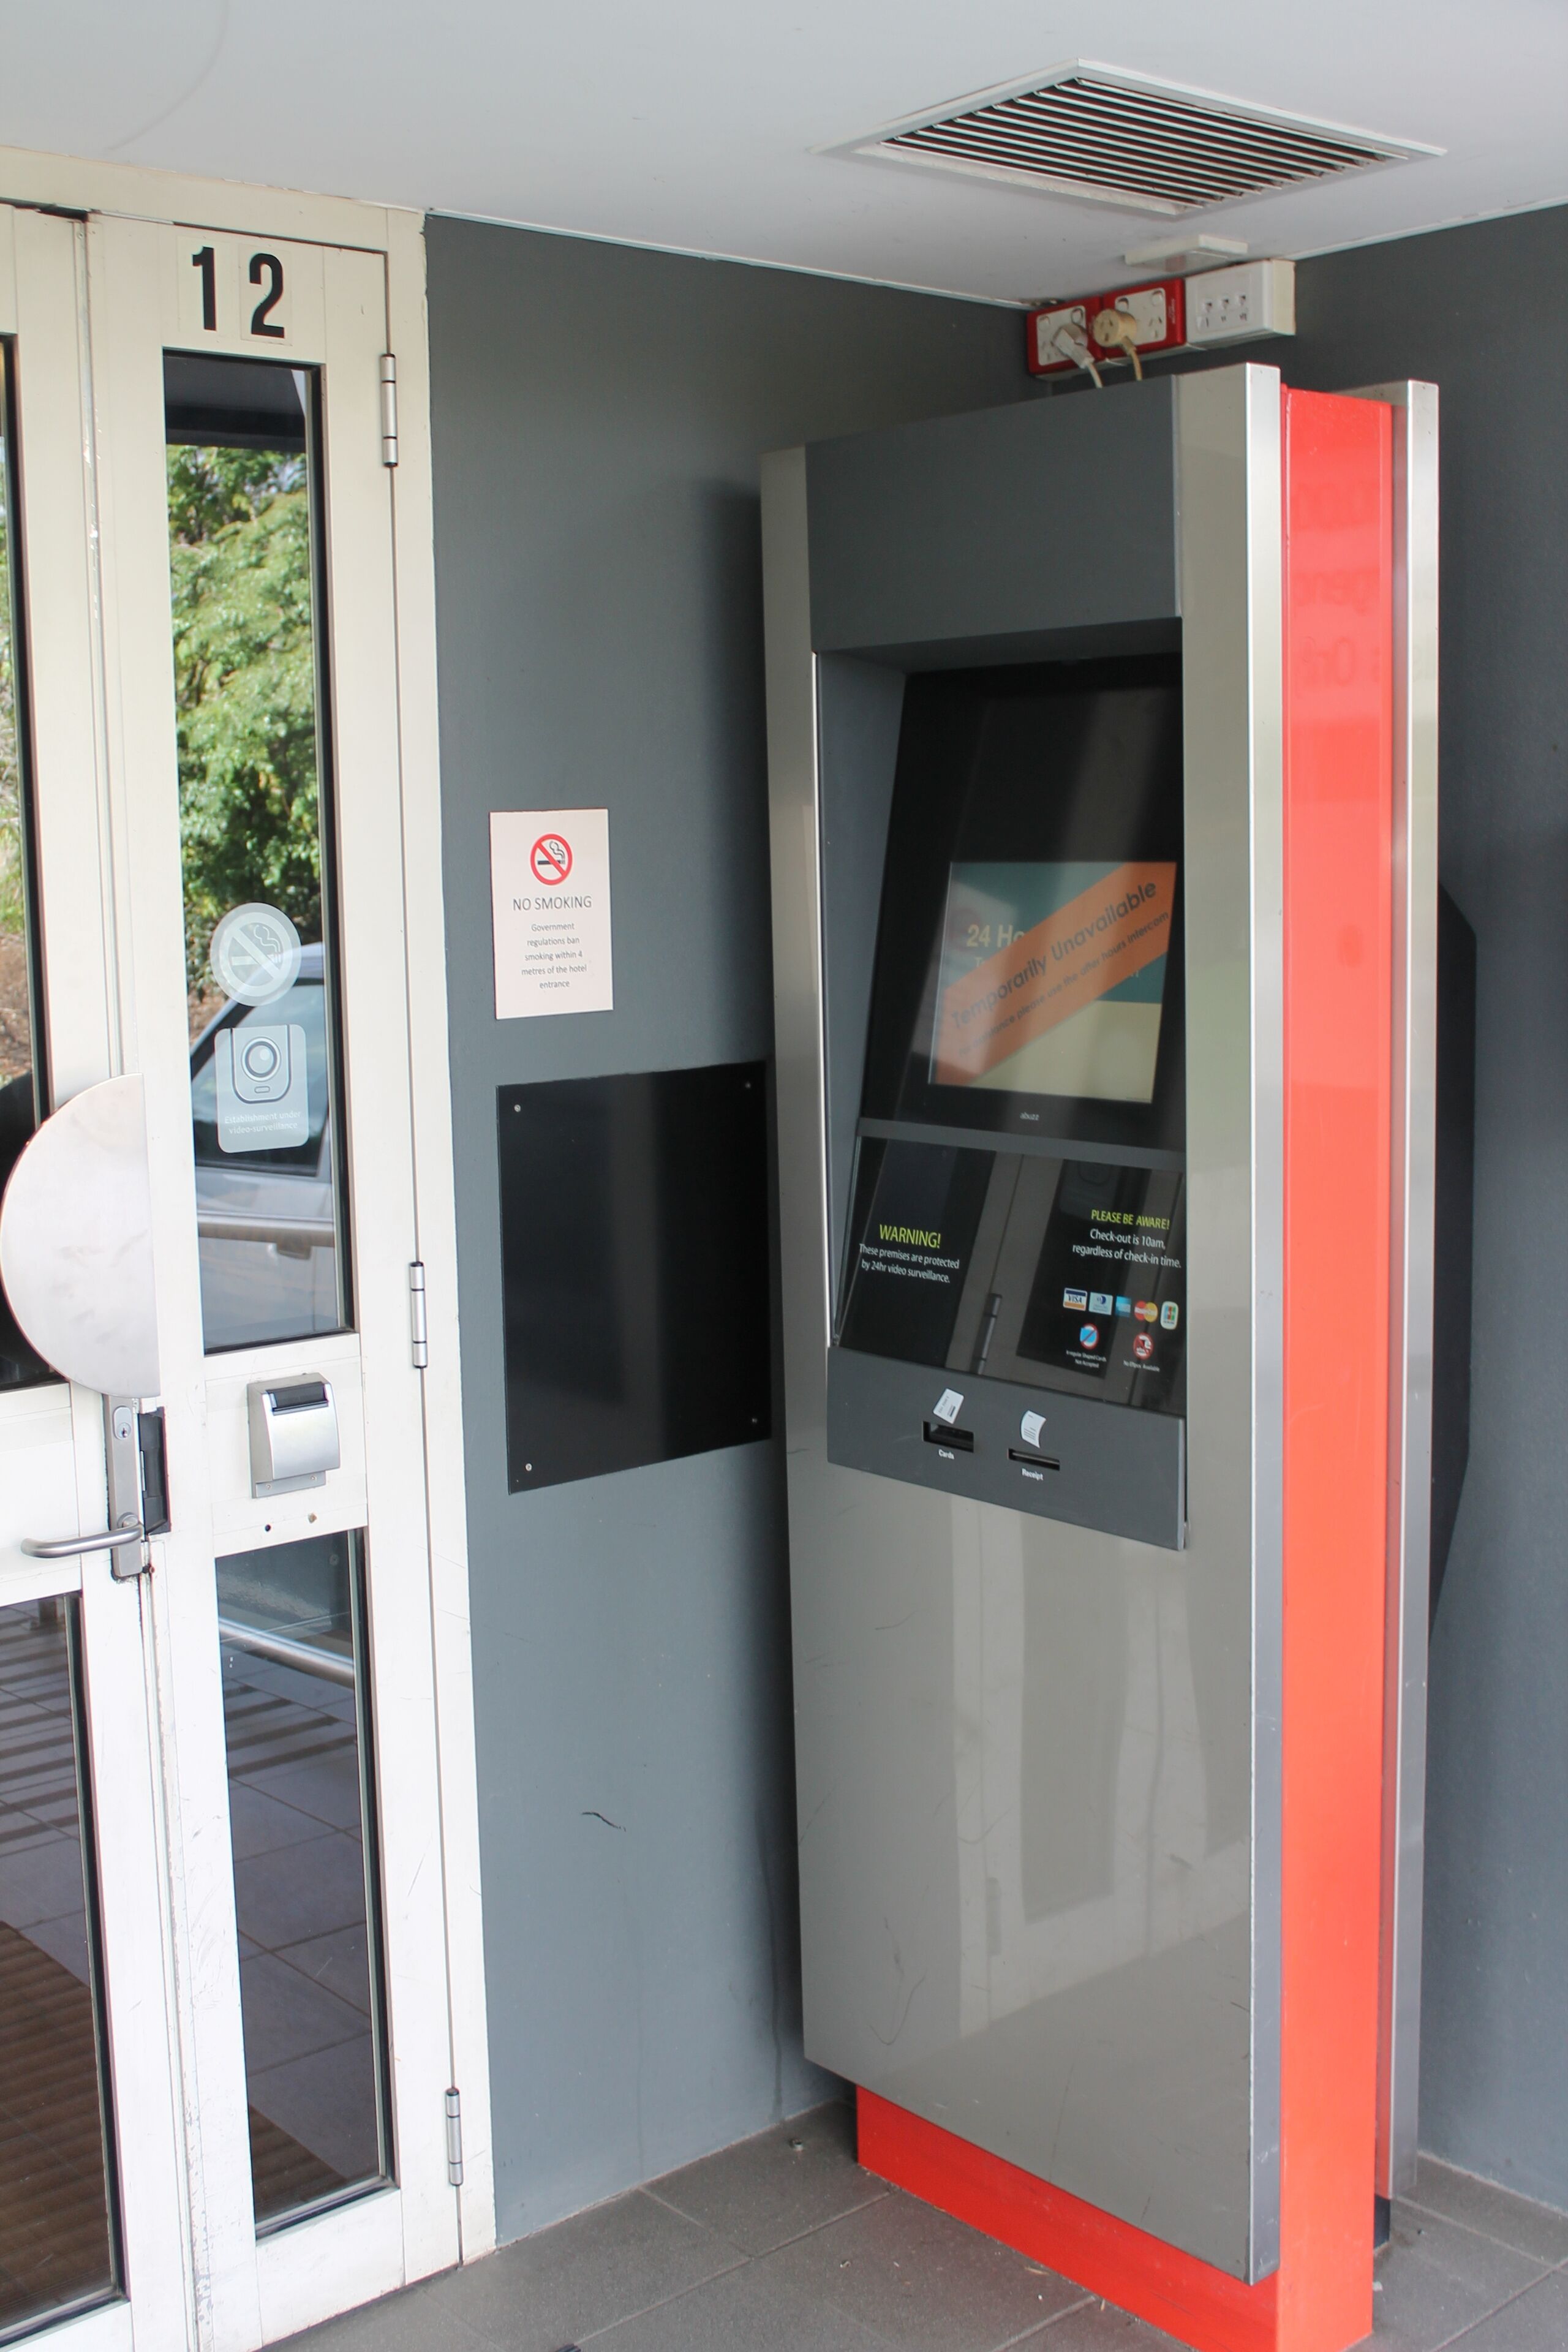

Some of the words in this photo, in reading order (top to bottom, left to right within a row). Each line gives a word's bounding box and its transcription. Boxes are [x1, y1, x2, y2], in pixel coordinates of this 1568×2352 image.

[192, 246, 285, 338] 12
[513, 898, 531, 911] NO
[535, 895, 592, 910] SMOKING
[531, 922, 575, 932] Government
[967, 924, 990, 948] 24
[527, 938, 565, 948] regulations
[525, 952, 554, 961] smoking
[556, 951, 576, 959] within
[952, 956, 1047, 1029] Temporarily
[1051, 883, 1156, 960] Unavailable
[569, 964, 587, 973] hotel
[1017, 995, 1045, 1019] please
[1047, 984, 1062, 998] use
[1063, 973, 1078, 986] the
[1080, 959, 1099, 976] after
[1101, 940, 1126, 961] hours
[225, 1113, 277, 1124] Establishment
[279, 1110, 301, 1119] under
[228, 1122, 298, 1134] video-surveillance
[1091, 1210, 1121, 1224] PLEASE
[1123, 1213, 1133, 1225] BE
[1136, 1216, 1170, 1230] AWARE!
[880, 1224, 941, 1249] WARNING!
[1090, 1228, 1131, 1244] Check-out
[1133, 1234, 1140, 1245] is
[1142, 1235, 1166, 1250] 10am,
[859, 1243, 878, 1256] These
[880, 1250, 910, 1261] premises
[911, 1254, 923, 1263] are
[924, 1256, 960, 1269] protected
[1072, 1245, 1113, 1258] regardless
[1114, 1249, 1124, 1259] of
[1124, 1251, 1158, 1265] check-in
[1160, 1256, 1182, 1268] time.
[861, 1259, 870, 1271] by
[872, 1261, 887, 1272] 24hr
[888, 1264, 907, 1276] video
[908, 1268, 950, 1283] surveillance.
[1068, 1294, 1082, 1304] VISA
[938, 1449, 955, 1460] Cards
[1022, 1468, 1044, 1480] Receipt
